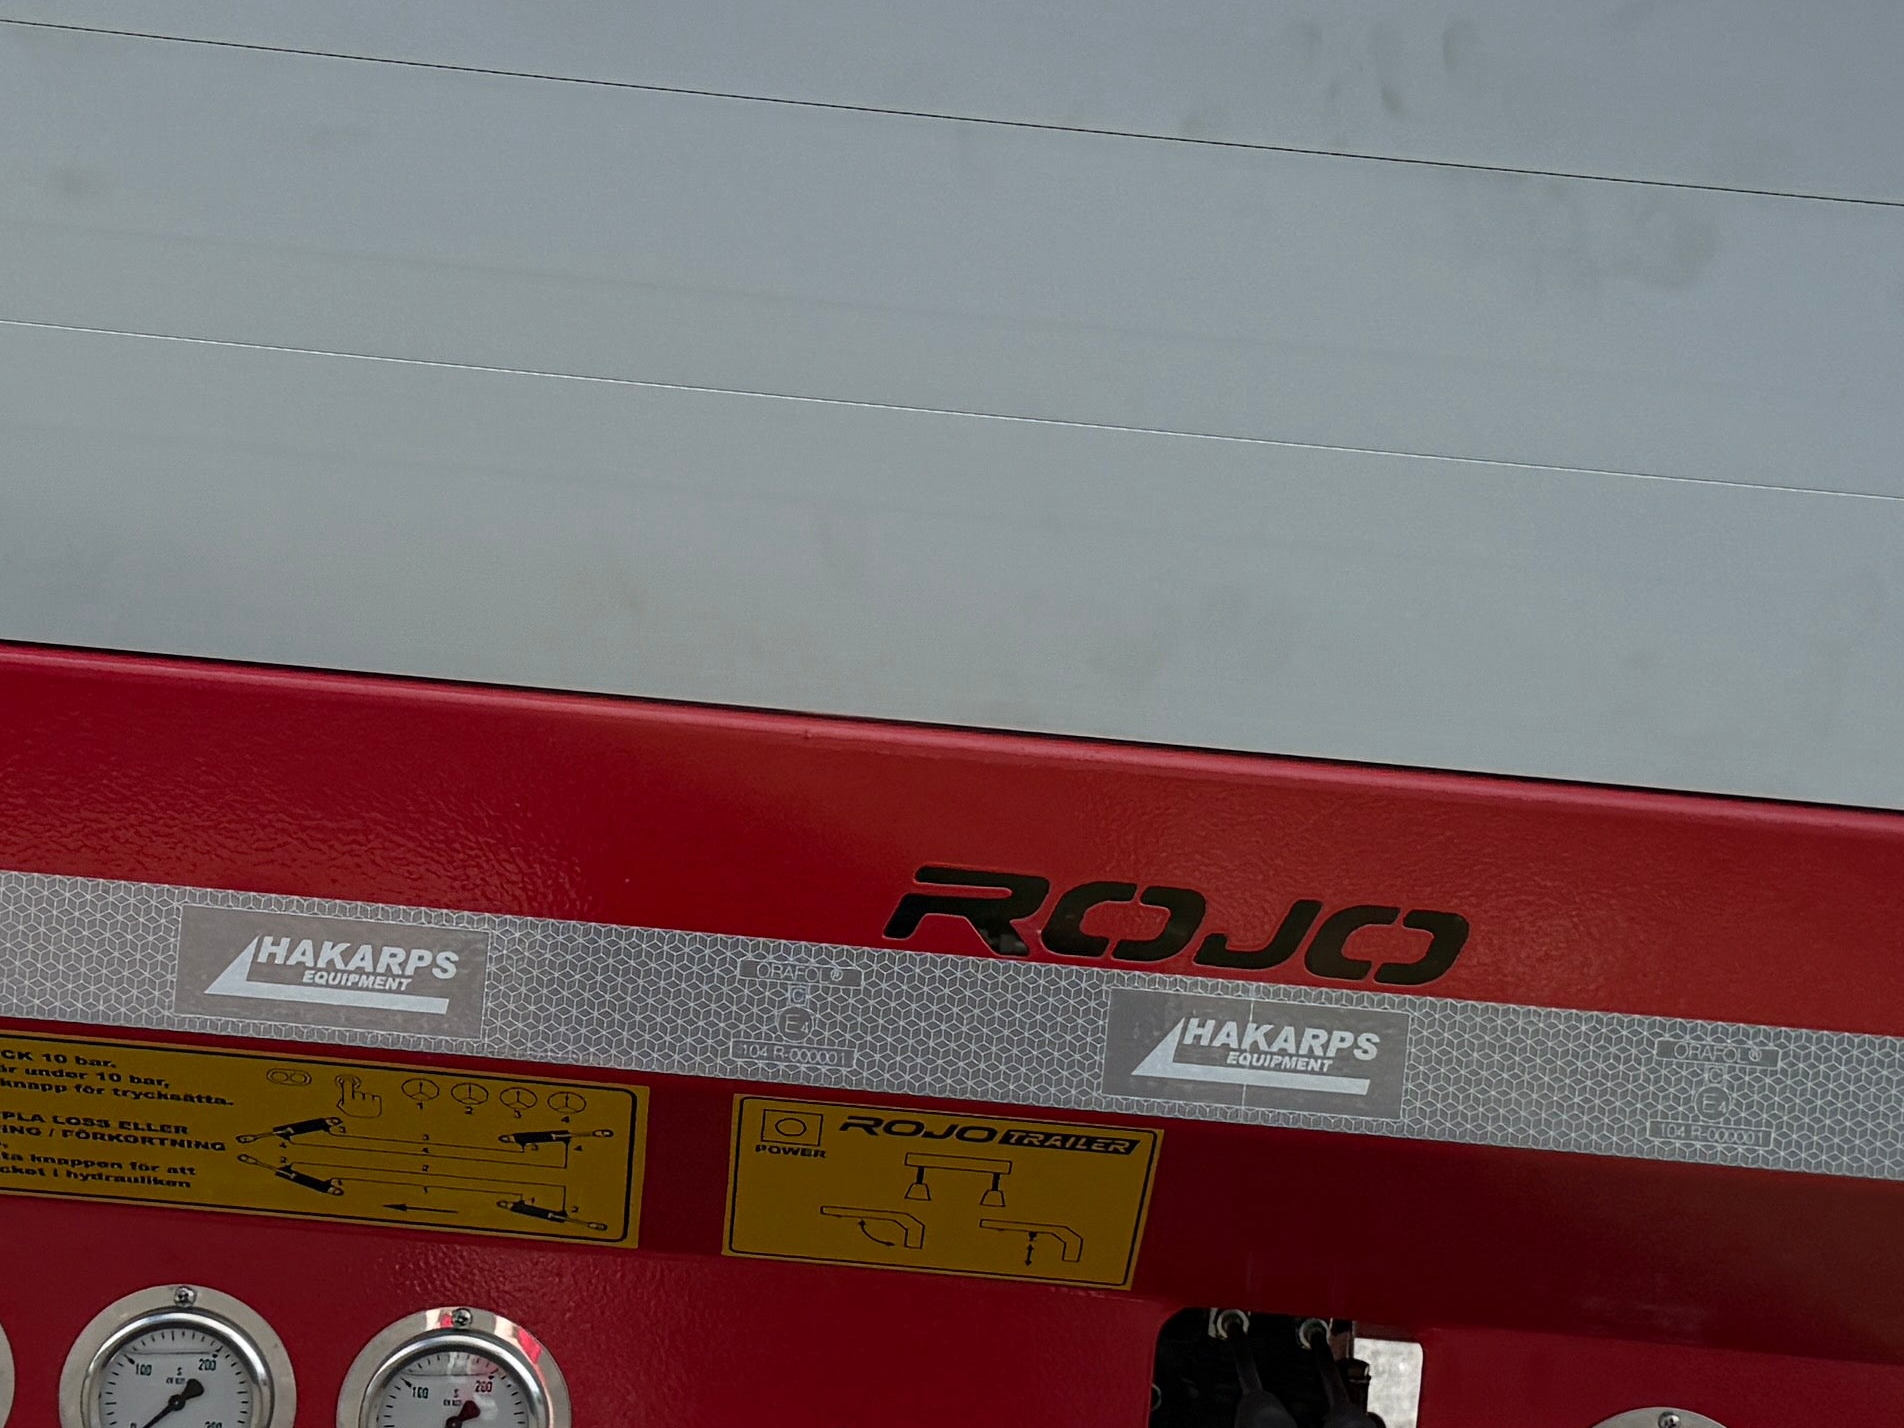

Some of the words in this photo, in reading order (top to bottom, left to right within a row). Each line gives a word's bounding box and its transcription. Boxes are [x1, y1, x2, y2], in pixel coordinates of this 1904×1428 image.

[882, 864, 1471, 986] ROJO
[256, 935, 459, 980] HAKARPS
[302, 970, 412, 991] EQUIPMENT
[1182, 1017, 1381, 1061] HAKARPS
[42, 1053, 68, 1063] 10
[1226, 1050, 1333, 1072] EQUIPMENT
[24, 1068, 88, 1080] under
[96, 1071, 122, 1082] 10
[52, 1114, 111, 1128] LOSS
[118, 1120, 189, 1135] ELLER
[839, 1114, 998, 1144] ROJO
[1005, 1130, 1133, 1154] TRAILER
[754, 1143, 827, 1159] POWER
